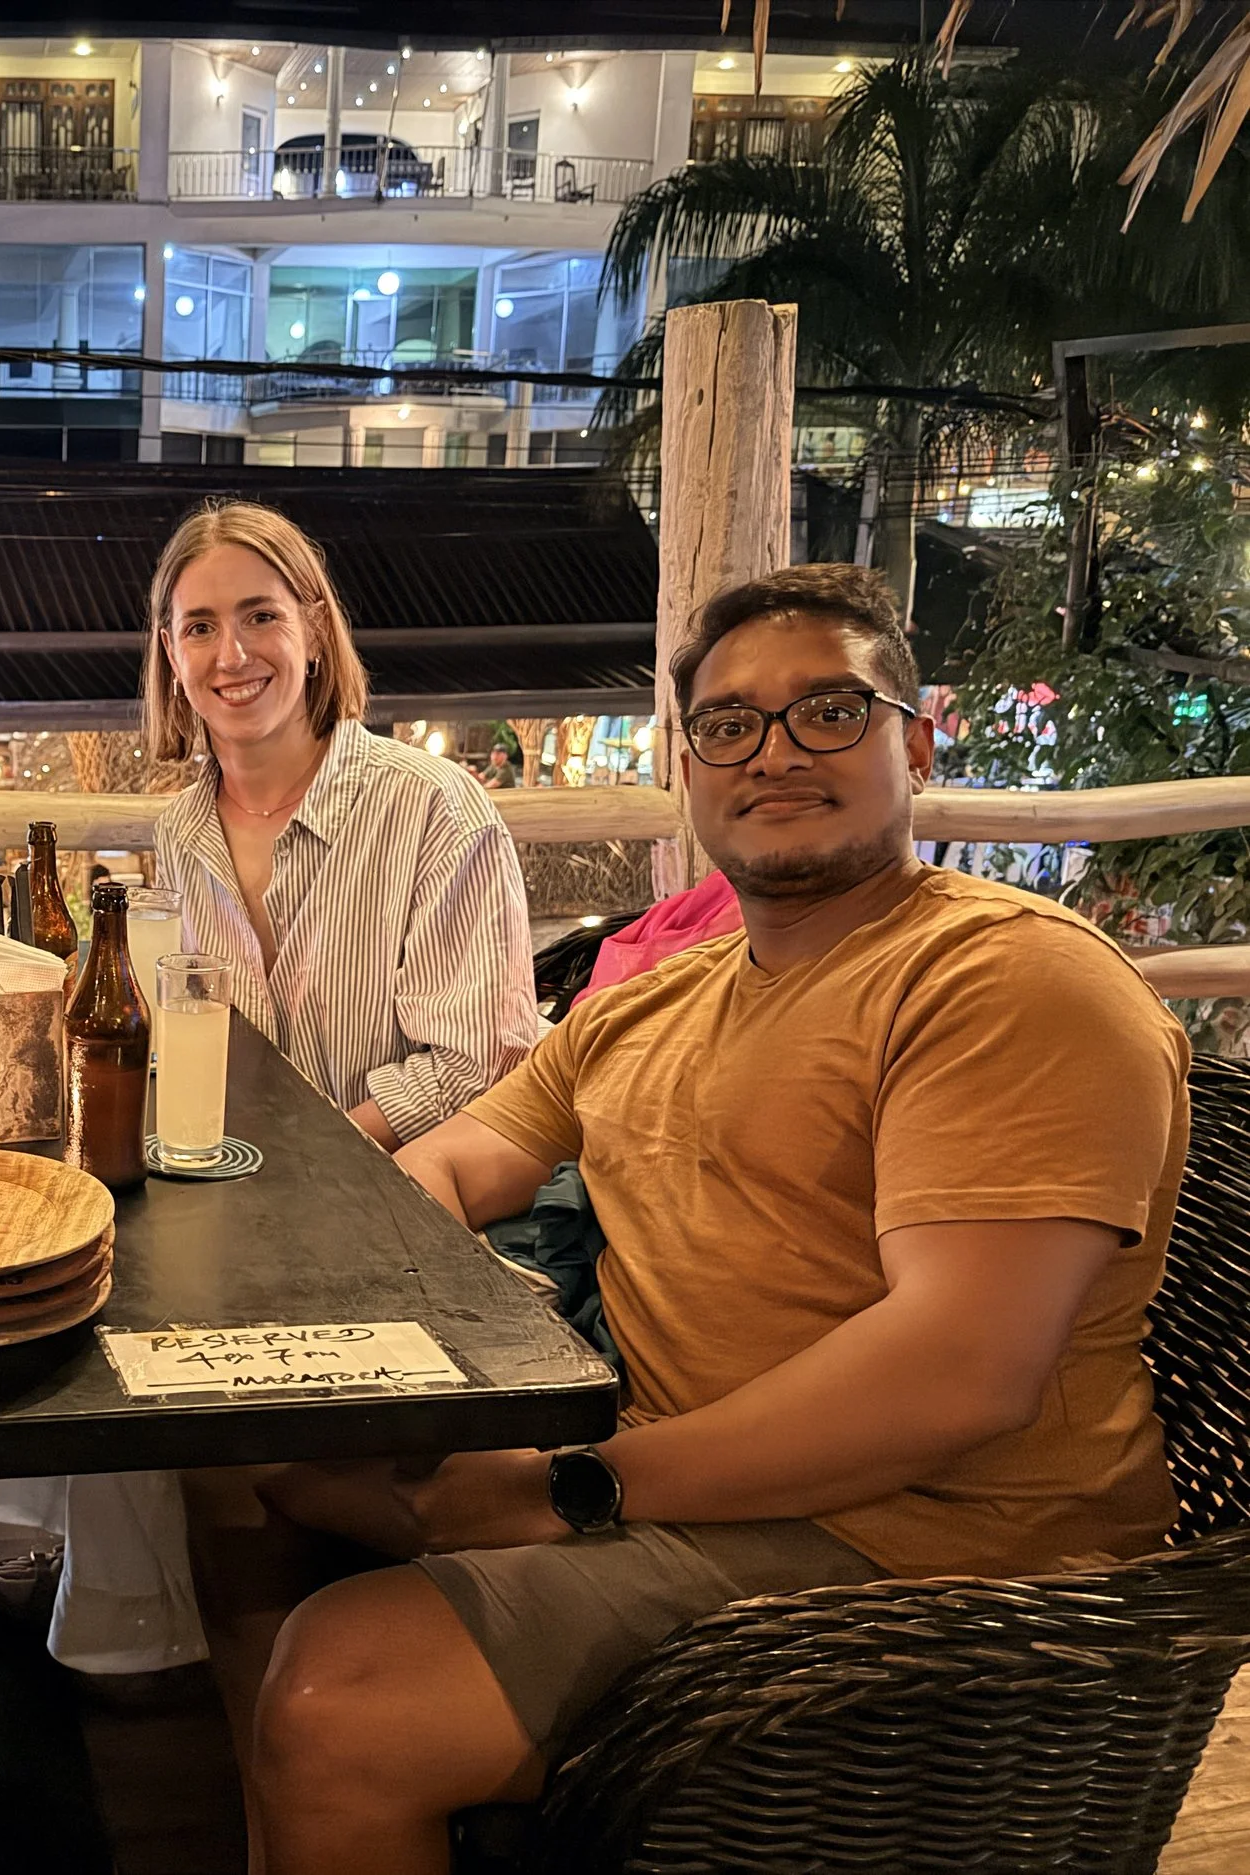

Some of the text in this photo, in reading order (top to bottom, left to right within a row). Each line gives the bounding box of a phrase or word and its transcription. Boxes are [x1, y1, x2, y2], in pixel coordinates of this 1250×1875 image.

[150, 1327, 375, 1352] RESERVED
[176, 1351, 216, 1370] 4
[262, 1348, 296, 1366] 7
